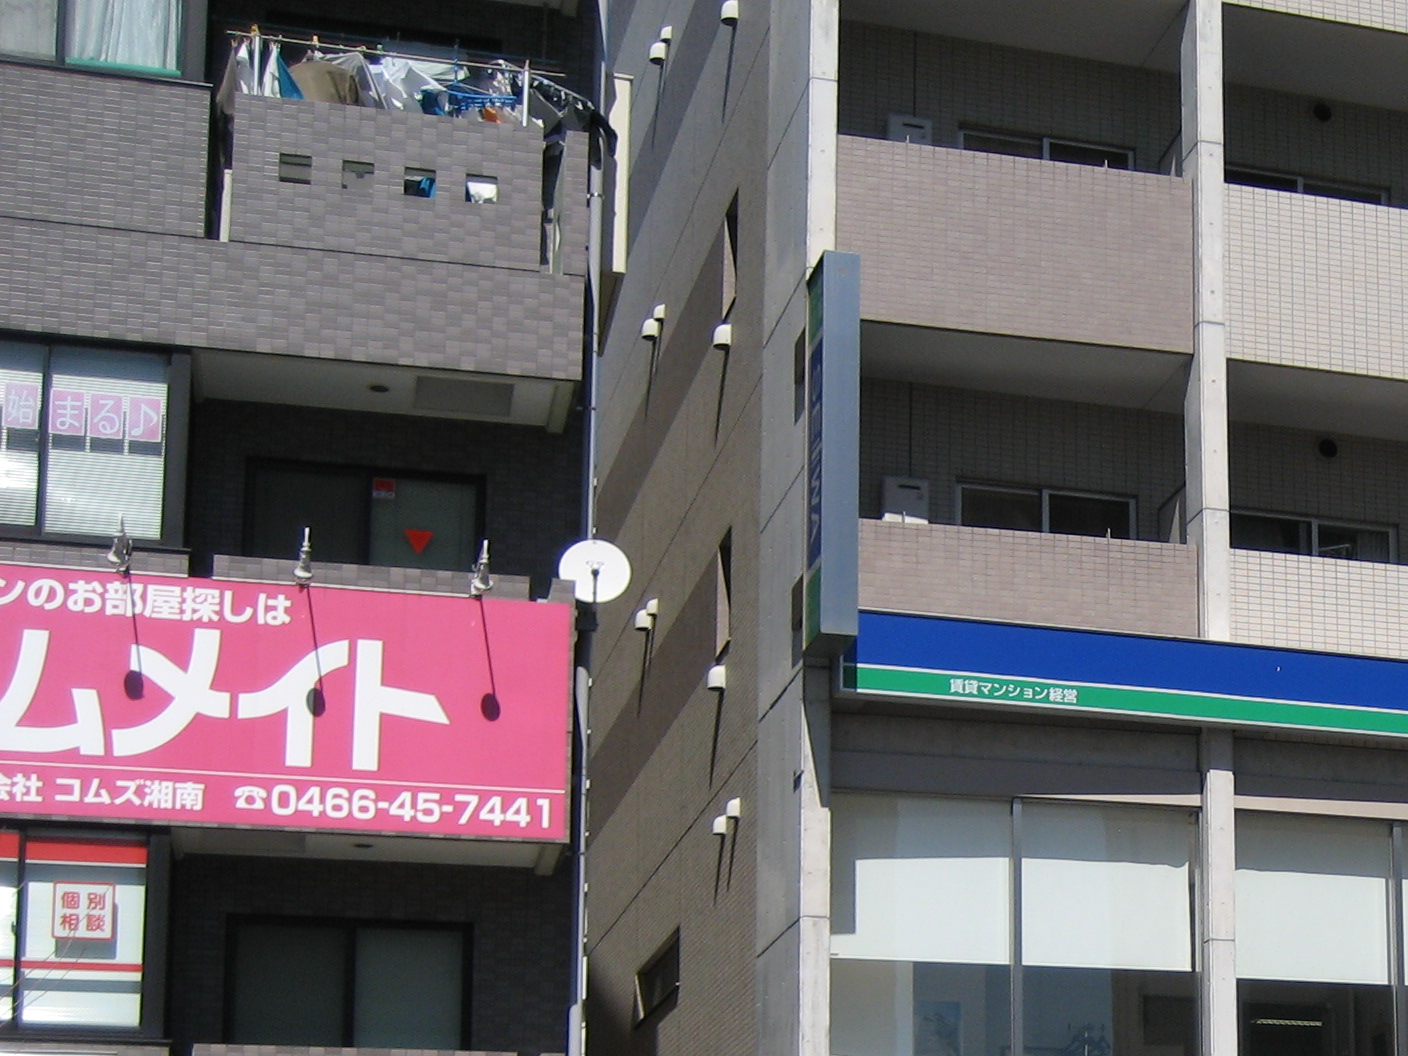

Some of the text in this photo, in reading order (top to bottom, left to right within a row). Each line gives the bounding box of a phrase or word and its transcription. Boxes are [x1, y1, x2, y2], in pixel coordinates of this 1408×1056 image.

[0, 628, 450, 771] ムメイト
[949, 677, 1078, 704] 賃貸マンション経営
[55, 778, 205, 811] コムズ湘南
[272, 785, 551, 829] 0466-45-7441
[61, 891, 106, 911] 個別
[60, 913, 106, 933] 相談
